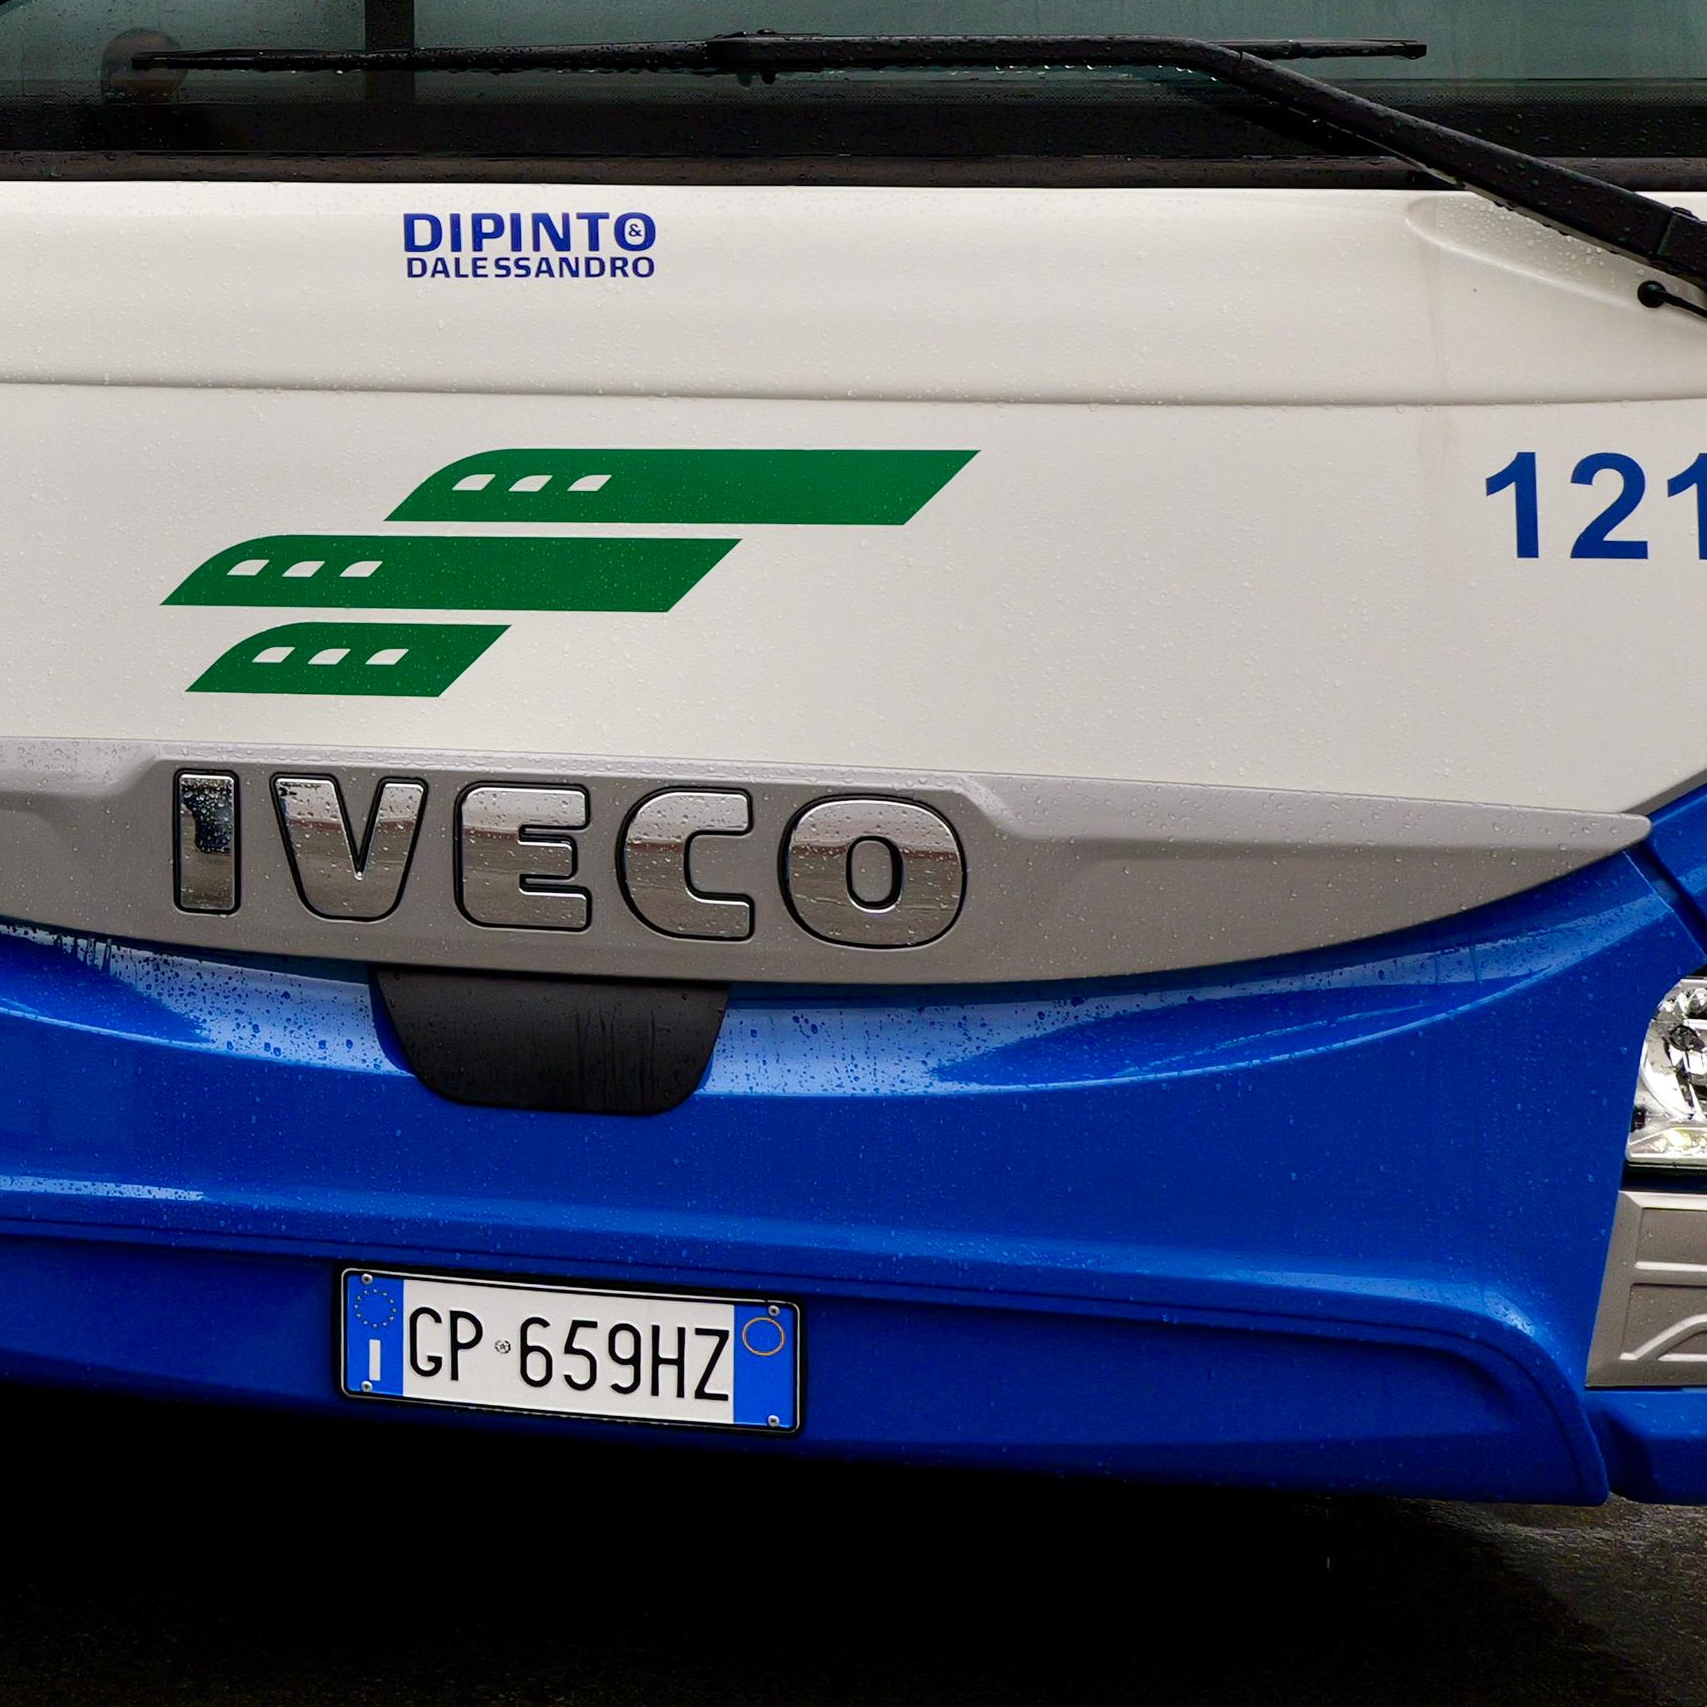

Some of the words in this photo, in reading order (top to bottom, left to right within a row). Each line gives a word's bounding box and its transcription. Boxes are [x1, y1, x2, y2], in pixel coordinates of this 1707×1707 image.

[403, 211, 657, 253] DIPINTO
[406, 256, 656, 279] DALESSANDRO
[1485, 451, 1707, 561] 121
[173, 768, 969, 950] IVECO
[408, 1306, 484, 1382] GP
[518, 1316, 730, 1402] 659HZ
